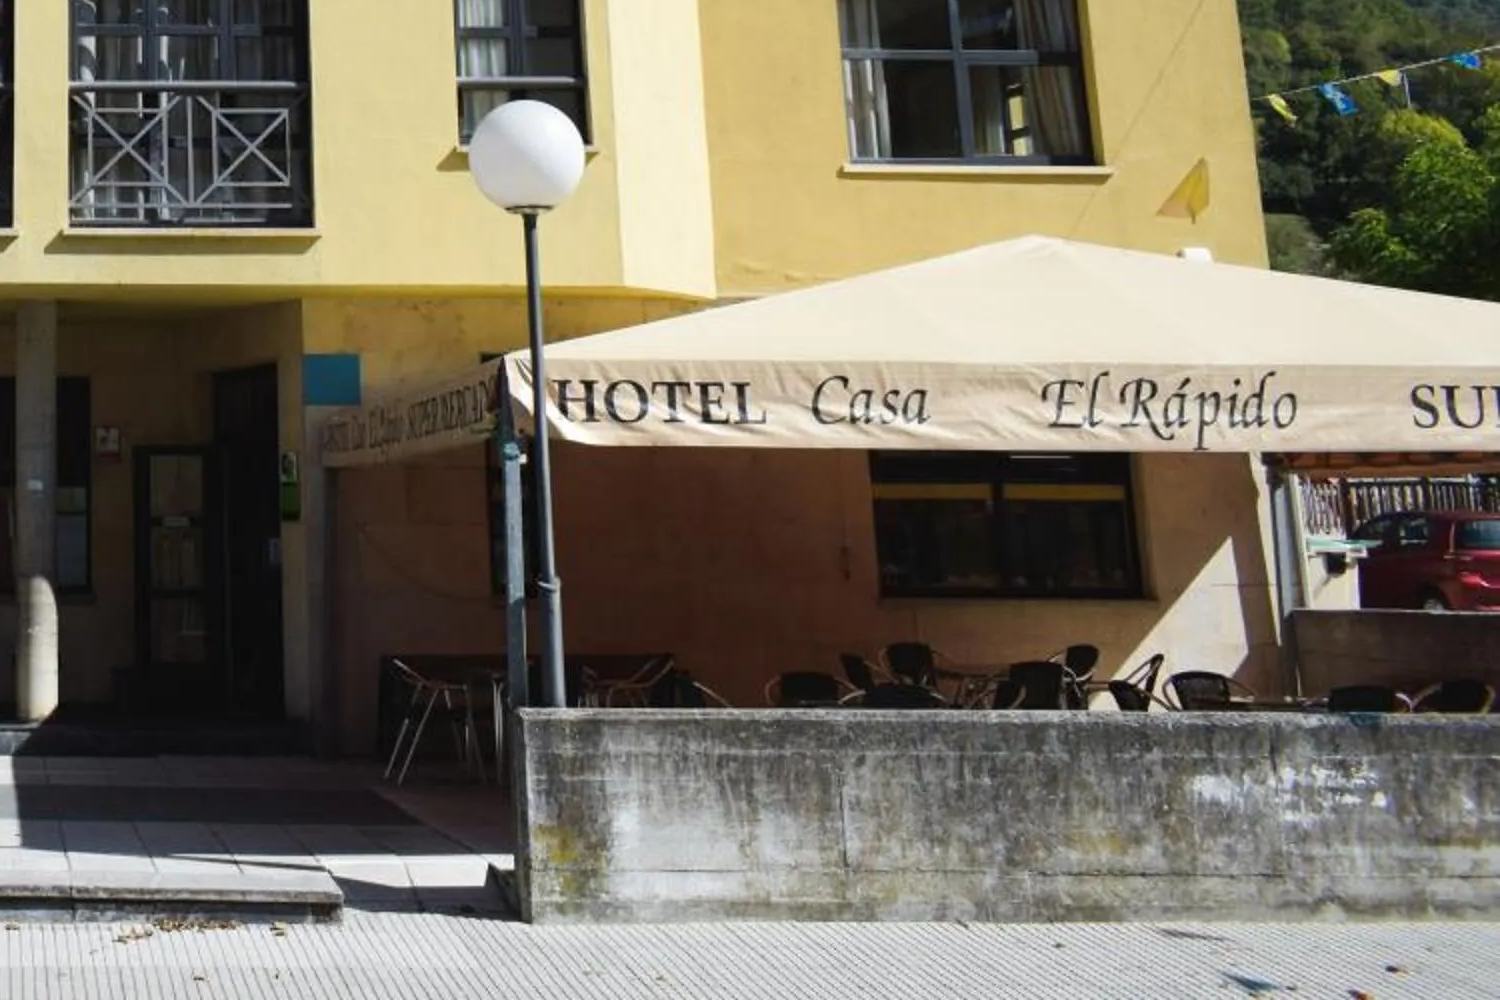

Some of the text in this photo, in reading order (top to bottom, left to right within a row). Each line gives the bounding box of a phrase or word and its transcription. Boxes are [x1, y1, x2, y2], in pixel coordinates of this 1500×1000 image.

[550, 378, 768, 426] HOTEL
[811, 374, 931, 426] Casa
[1040, 370, 1110, 430] El
[1118, 370, 1299, 451] Rápido
